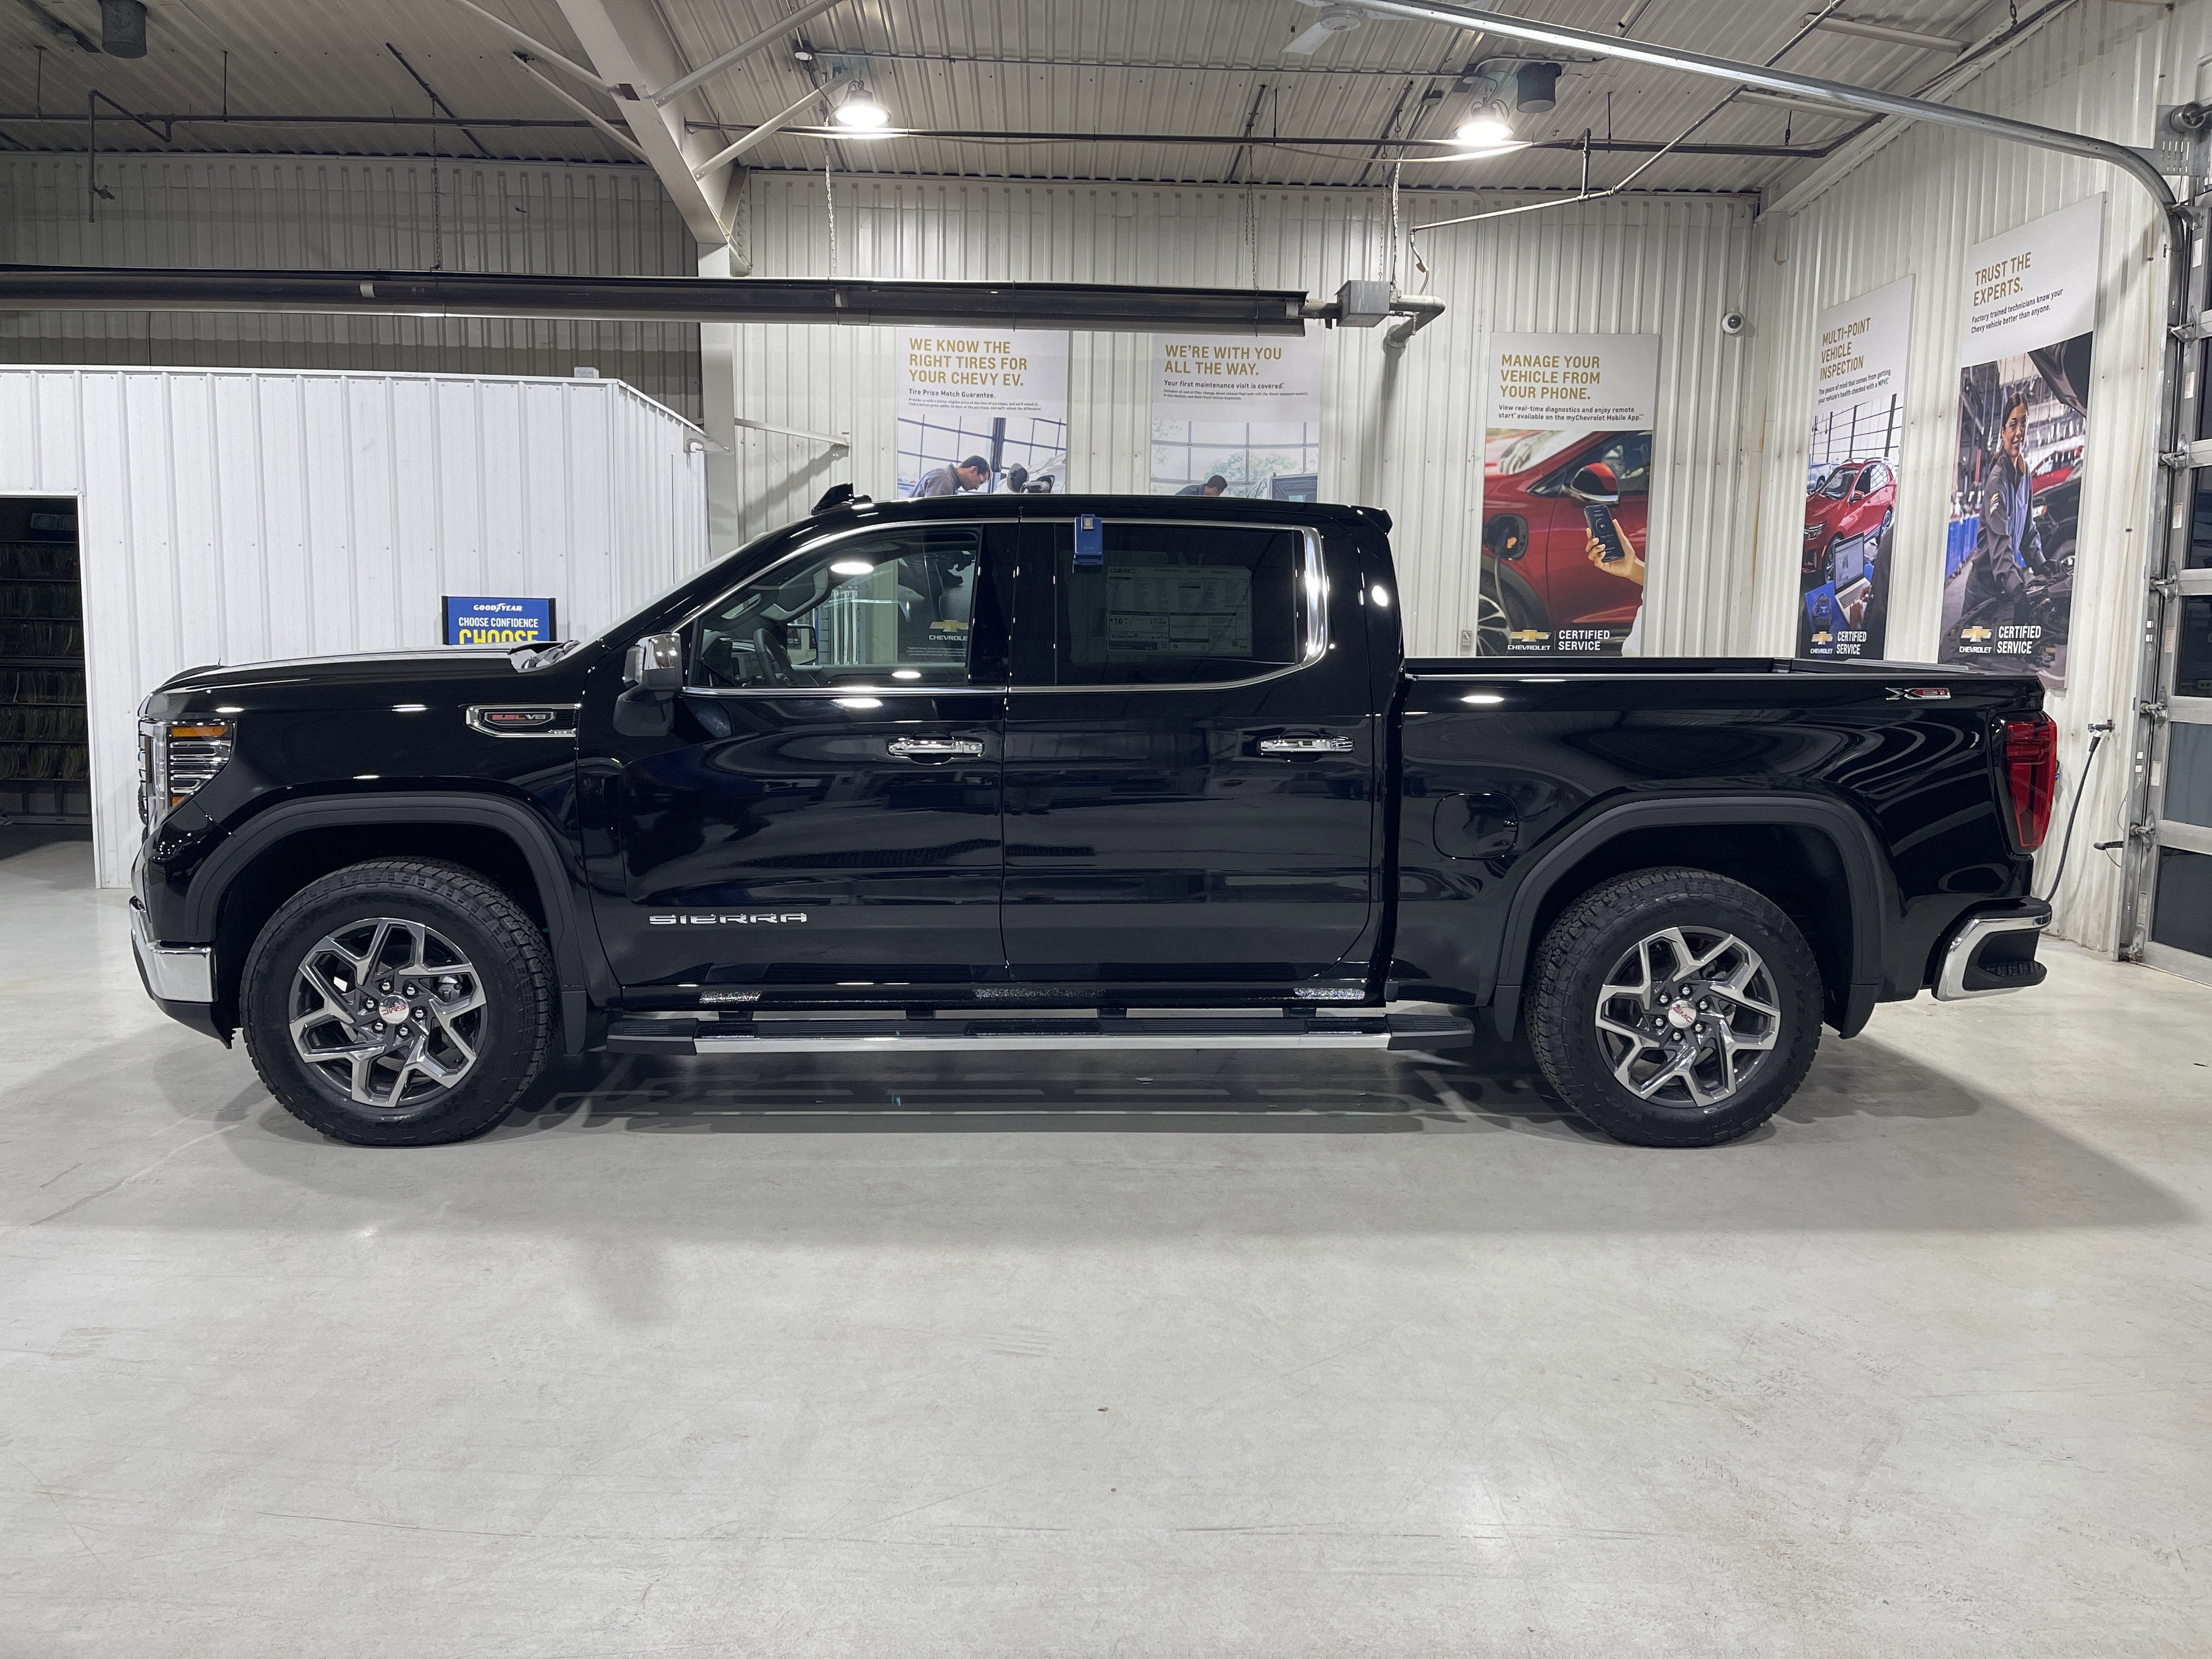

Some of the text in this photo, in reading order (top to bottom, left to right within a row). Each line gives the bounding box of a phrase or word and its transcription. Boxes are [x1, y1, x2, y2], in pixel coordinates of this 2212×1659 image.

[1975, 251, 2032, 286] TRUST THE
[1973, 276, 2023, 307] EXPERTS.
[1972, 289, 2063, 323] Factory trained technicians know your
[1971, 304, 2051, 334] Chevy vehicle better than anyone.
[1822, 318, 1871, 347] MULTI-POINT
[910, 338, 1011, 354] WE KNOW THE
[1165, 345, 1282, 360] WE'RE WITH YOU
[1821, 342, 1852, 363] VEHICLE
[910, 354, 1027, 370] RIGHT TIRES FOR
[1164, 360, 1259, 375] ALL THE WAY.
[1502, 354, 1600, 369] MANAGE YOUR
[1820, 355, 1864, 381] INSPECTION
[909, 370, 1024, 386] YOUR CHEVY EV.
[1501, 370, 1600, 384] VEHICLE FROM
[1500, 385, 1590, 400] YOUR PHONE.
[473, 603, 523, 613] GOODYEAR
[459, 617, 538, 628] CHOOSE CONFIDENCE
[1559, 630, 1610, 640] CERTIFIED
[1838, 631, 1866, 642] CERTIFIED
[1999, 625, 2041, 639] CERTIFIED
[1558, 641, 1601, 651] SERVICE
[1836, 644, 1860, 655] SERVICE
[1997, 641, 2033, 654] SERVICE
[650, 912, 807, 924] SIERRA
[381, 1005, 406, 1015] GMC
[1673, 1006, 1693, 1023] GMC
